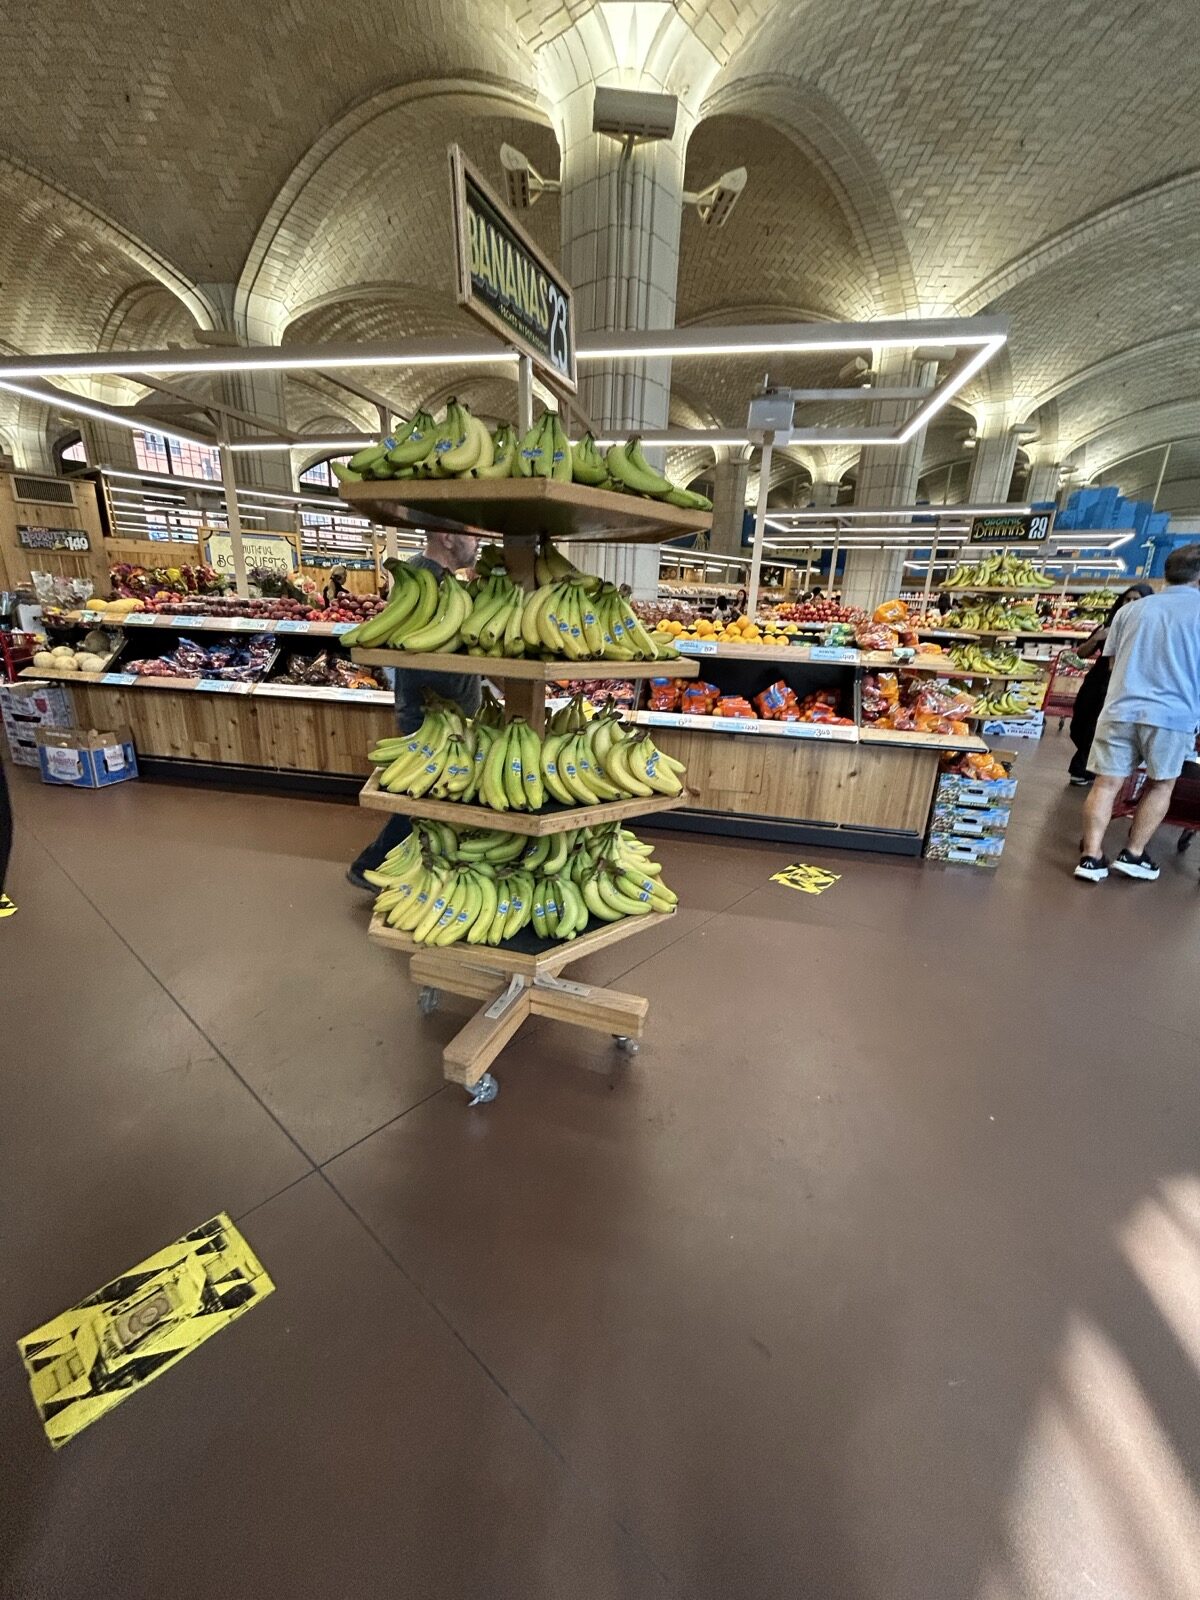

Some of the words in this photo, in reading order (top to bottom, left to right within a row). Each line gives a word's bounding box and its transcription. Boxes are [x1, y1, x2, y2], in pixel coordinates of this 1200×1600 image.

[467, 205, 548, 331] BANANAS
[549, 284, 568, 371] 23
[984, 517, 1023, 526] ORGANIC
[1028, 516, 1049, 539] 29
[217, 555, 288, 570] BOQUETS
